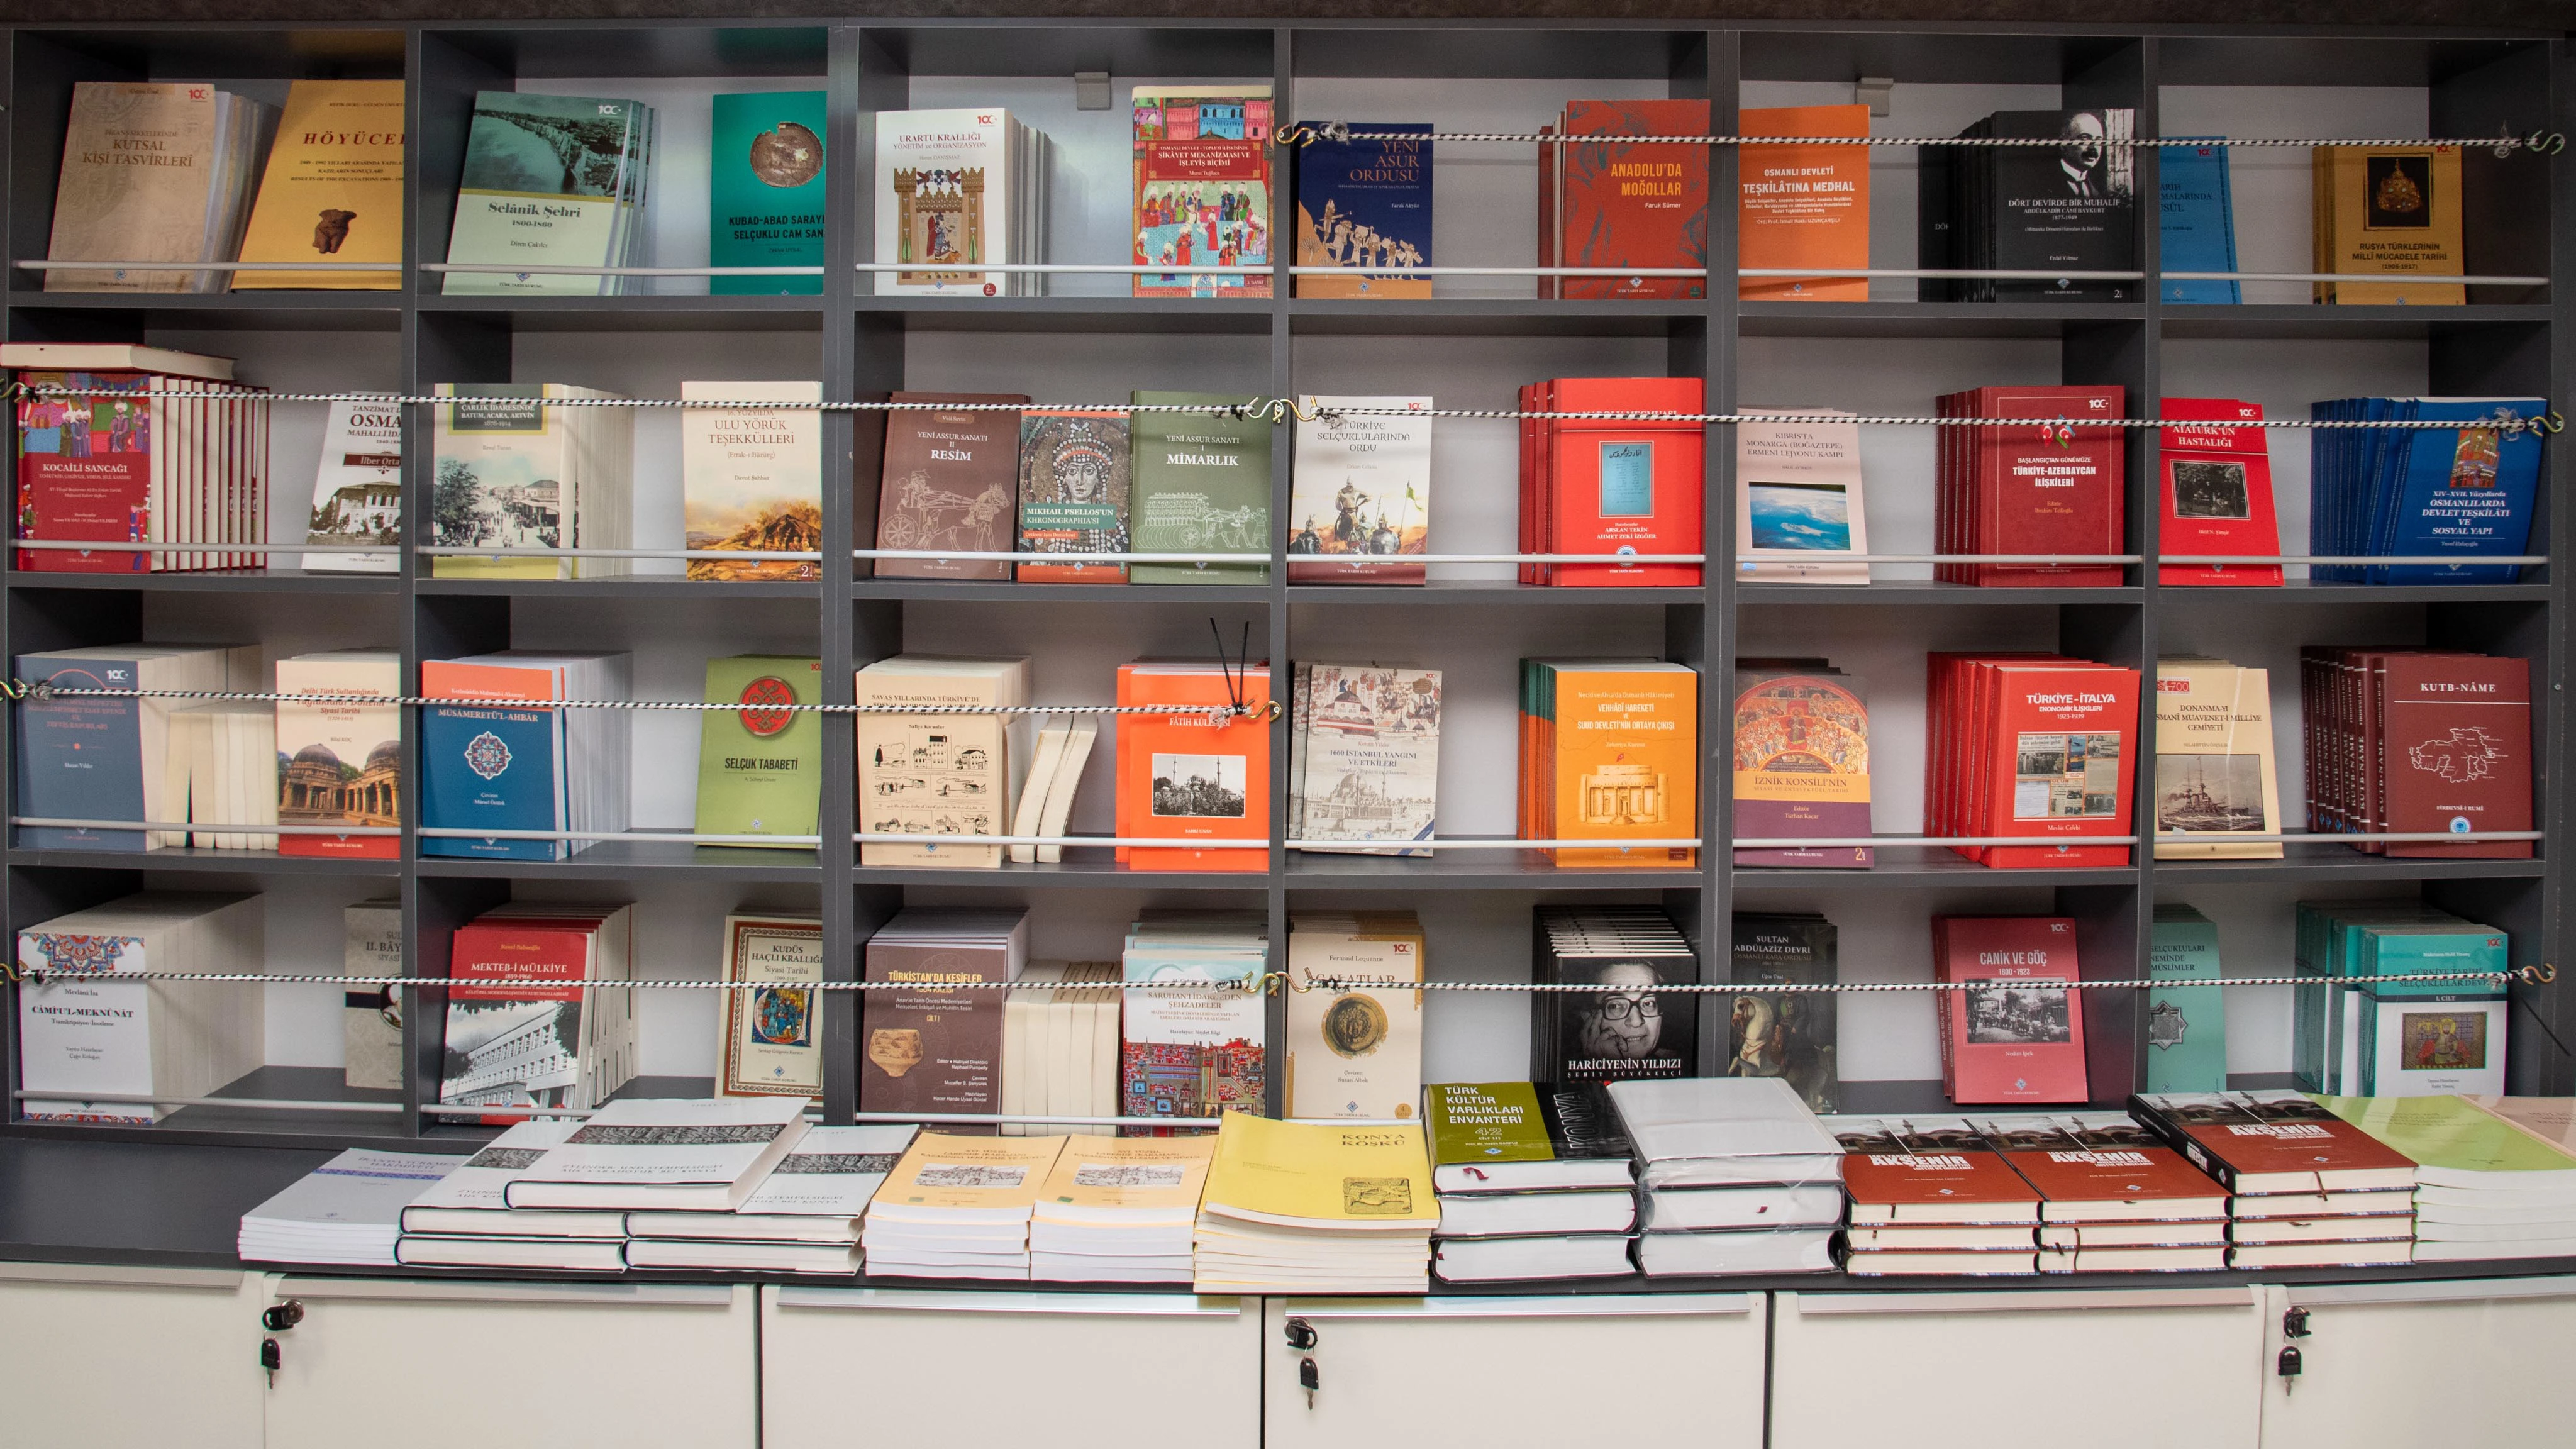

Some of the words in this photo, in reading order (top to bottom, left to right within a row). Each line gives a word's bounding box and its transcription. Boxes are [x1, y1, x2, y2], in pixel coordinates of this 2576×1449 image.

[900, 134, 935, 142] URARTU
[938, 133, 980, 142] KRALLIĞI
[113, 139, 165, 152] KUTSAL
[84, 152, 109, 165] KİŞİ
[114, 152, 192, 167] TASVİRLERİ
[1376, 156, 1418, 167] ASUR
[1350, 170, 1418, 181] ORDUSU
[1611, 164, 1681, 177] ANADOLU'DA
[1765, 167, 1798, 176] OSMANLI
[1801, 166, 1833, 176] DEVLETİ
[1622, 180, 1680, 196] MOĞOLLAR
[1813, 180, 1855, 192] MEDHAL
[2009, 199, 2030, 207] DÖRT
[2033, 199, 2067, 207] DEVİRDE
[2069, 199, 2081, 207] BİR
[2084, 199, 2120, 207] MUHALİF
[489, 202, 538, 216] Selânik
[544, 205, 580, 218] Şehri
[730, 216, 789, 226] KUBAD-ABAD
[735, 230, 779, 242] SELÇUKLU
[783, 230, 801, 239] CAM
[715, 419, 739, 430] ULU
[744, 418, 786, 430] YÖRÜK
[348, 429, 386, 437] MAHALLİ
[918, 430, 935, 438] YENİ
[1318, 431, 1409, 441] SELÇUKLULARINDA
[708, 433, 794, 446] TEŞEKKÜLLERİ
[2179, 437, 2231, 447] HASTALIĞI
[1350, 443, 1376, 452] ORDU
[932, 448, 970, 461] RESİM
[1168, 452, 1238, 466] MİMARLIK
[360, 457, 380, 465] İlber
[2018, 457, 2059, 465] BAŞLANGIÇTAN
[43, 464, 82, 472] KOCAİLİ
[85, 464, 127, 474] SANCAĞI
[2013, 465, 2096, 476] TÜRKİYE-AZERBAYCAN
[2035, 477, 2074, 488] İLİŞKİLERİ
[2421, 682, 2495, 692] KUTB-NÂME
[2026, 693, 2072, 704] TÜRKİYE
[2080, 692, 2115, 704] İTALYA
[1624, 702, 1654, 712] HAREKETİ
[2073, 704, 2102, 713] İLİŞKİLERİ
[1169, 716, 1191, 726] FÂTİH
[1578, 721, 1593, 730] SUUD
[1632, 721, 1655, 730] ORTAYA
[1657, 721, 1675, 731] ÇIKIŞI
[1346, 749, 1383, 758] İSTANBUL
[1385, 751, 1416, 759] YANGINI
[725, 758, 756, 770] SELÇUK
[760, 757, 797, 770] TABABETİ
[1361, 758, 1396, 767] ETKİLERİ
[1755, 775, 1782, 785] İZNİK
[774, 945, 802, 953] KUDÜS
[1735, 944, 1782, 953] ABDÜLAZİZ
[1785, 945, 1809, 953] DEVRİ
[1980, 951, 2010, 965] CANİK
[2012, 952, 2025, 965] VE
[2028, 952, 2046, 966] GÖÇ
[472, 962, 516, 972] MEKTEB-İ
[520, 963, 566, 973] MÜLKİYE
[889, 970, 943, 983] TÜRKİSTAN'DA
[1169, 1001, 1221, 1010] ŞEHZADELER
[1569, 1058, 1638, 1070] HARİCİYENİN
[1643, 1059, 1680, 1069] YILDIZI
[1446, 1096, 1496, 1104] KÜLTÜR
[1450, 1114, 1522, 1124] ENVANTERİ
[1553, 1092, 1599, 1148] KONYA
